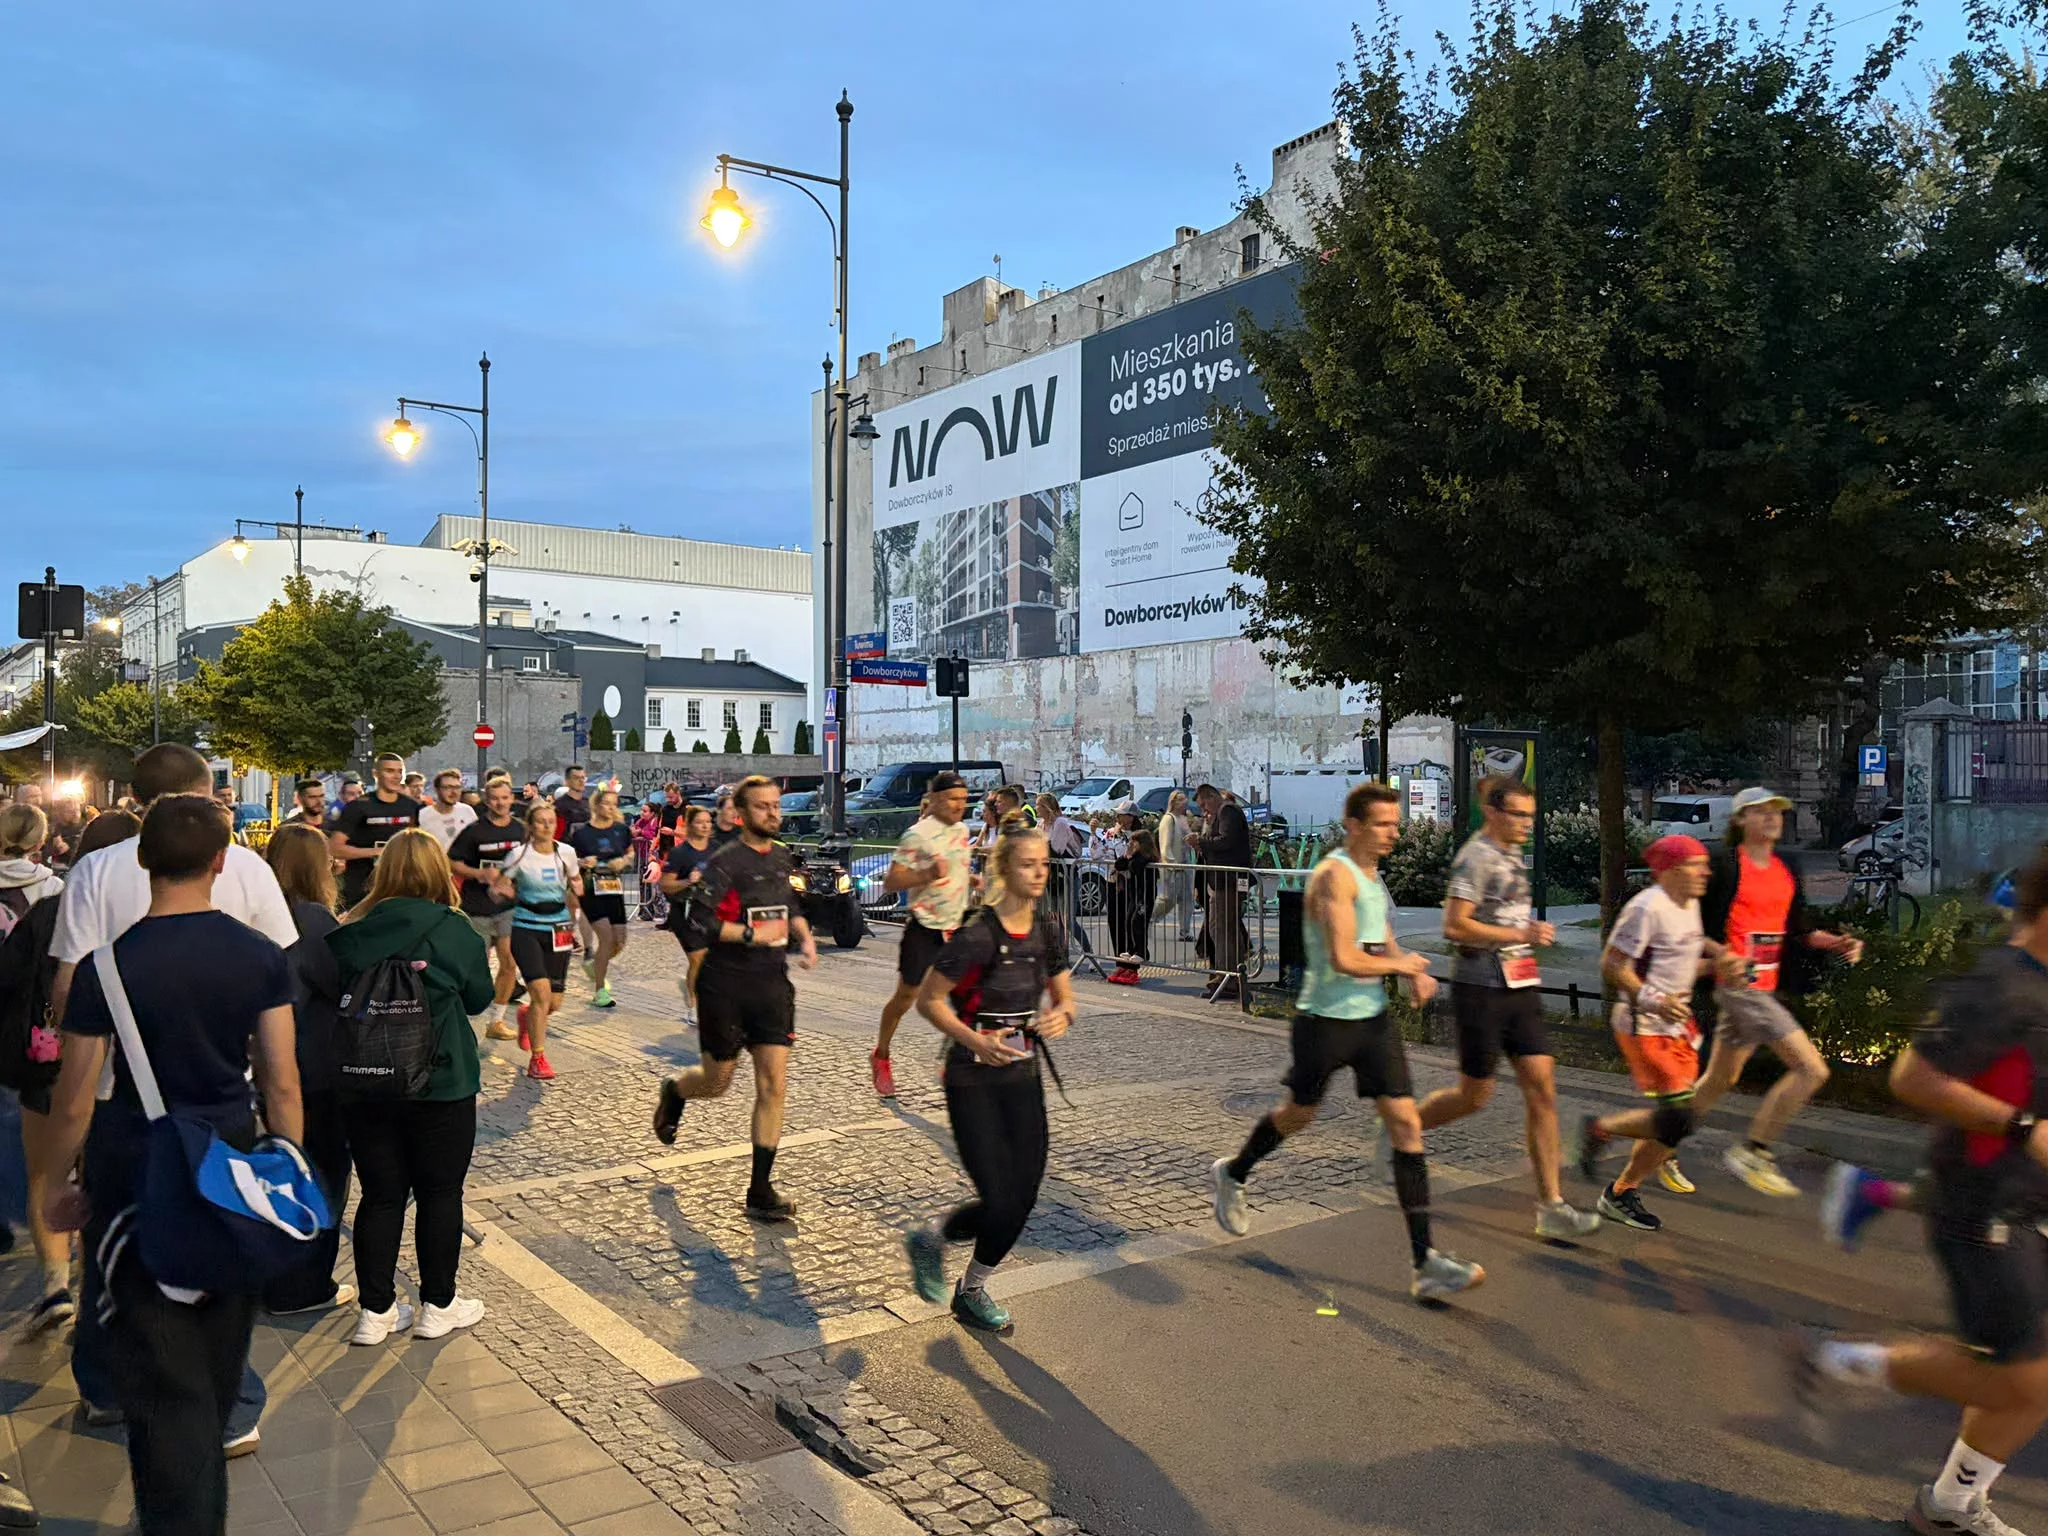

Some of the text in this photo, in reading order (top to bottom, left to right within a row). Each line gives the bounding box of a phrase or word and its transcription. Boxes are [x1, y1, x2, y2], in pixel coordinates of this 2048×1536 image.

[1110, 320, 1234, 382] Mieszkania
[1109, 358, 1241, 415] od 350 tys.
[889, 375, 1058, 488] NOW
[1108, 423, 1170, 457] Sprzedaż
[888, 484, 953, 512] Dowborczyków 18
[1110, 552, 1152, 568] Smart Home
[1143, 540, 1159, 552] dom
[1105, 593, 1226, 627] Dowborczyków
[862, 665, 919, 679] Dowborczyków
